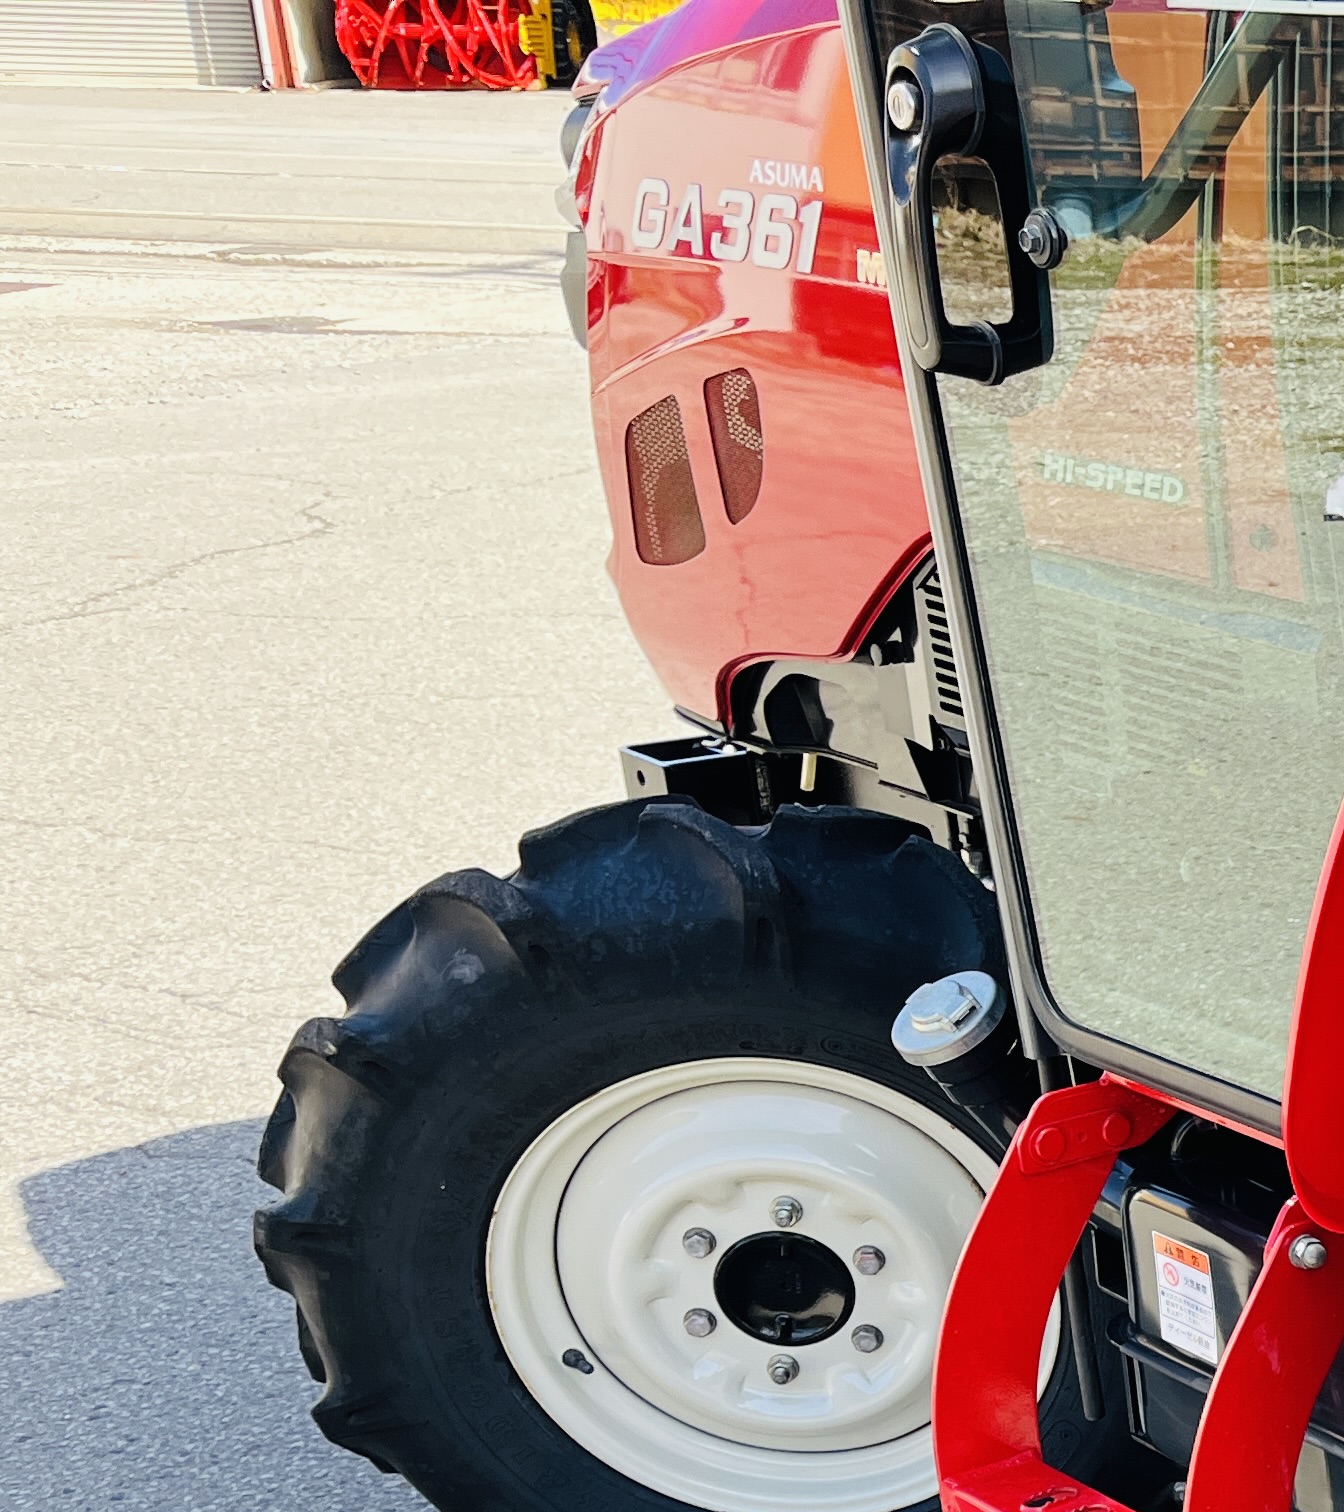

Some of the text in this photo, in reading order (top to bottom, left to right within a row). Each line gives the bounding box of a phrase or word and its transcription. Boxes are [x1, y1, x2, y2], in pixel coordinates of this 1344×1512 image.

[750, 159, 824, 192] ASUMA
[632, 178, 824, 274] GA361
[1043, 453, 1185, 503] HI-SPEED
